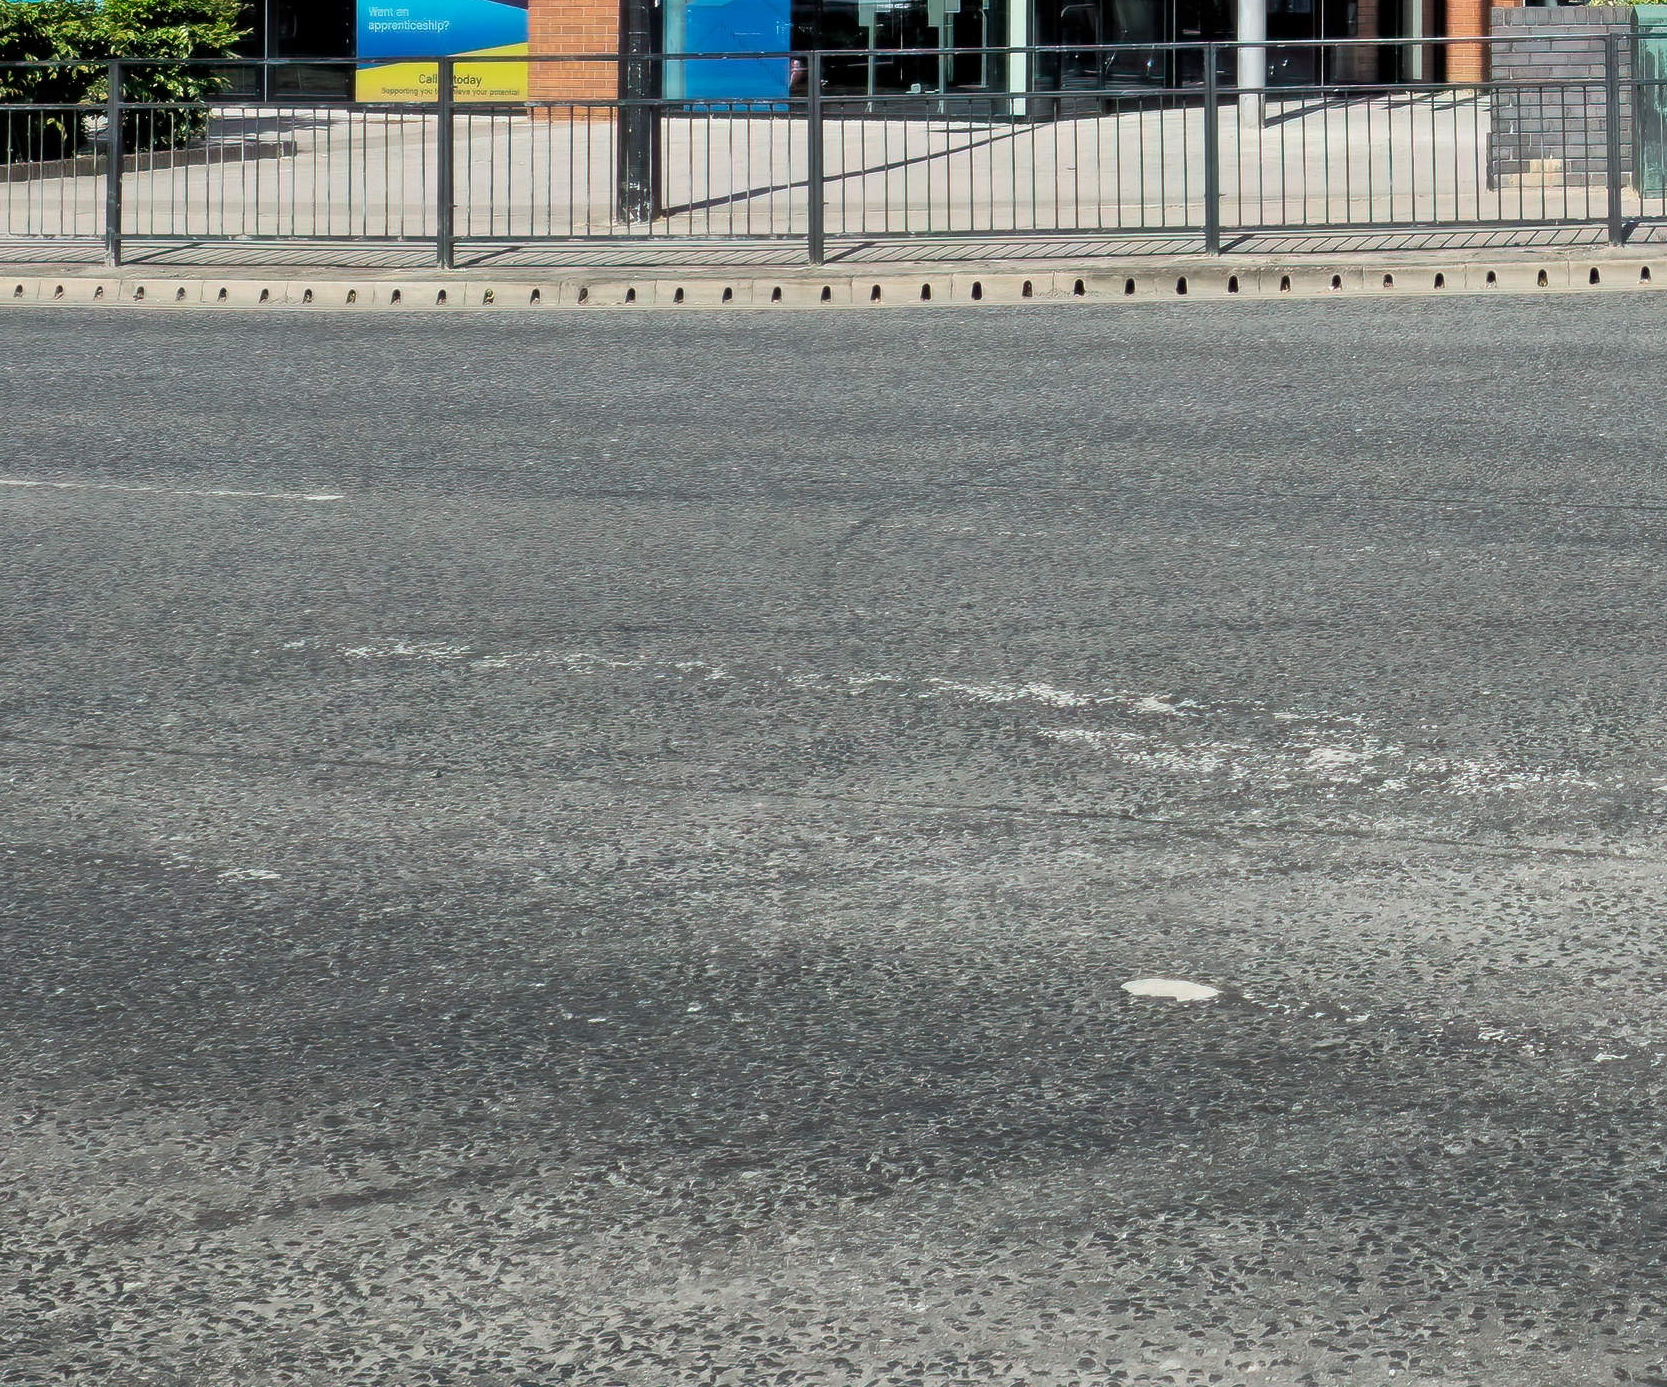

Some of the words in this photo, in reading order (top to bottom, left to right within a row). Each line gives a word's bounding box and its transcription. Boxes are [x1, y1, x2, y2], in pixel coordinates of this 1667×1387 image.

[369, 6, 394, 17] Want
[396, 8, 409, 17] an
[369, 19, 450, 33] apprenticeship?
[453, 74, 482, 87] today
[382, 87, 418, 96] Supporting
[420, 88, 434, 97] you
[473, 88, 487, 96] your
[489, 87, 520, 96] potential
